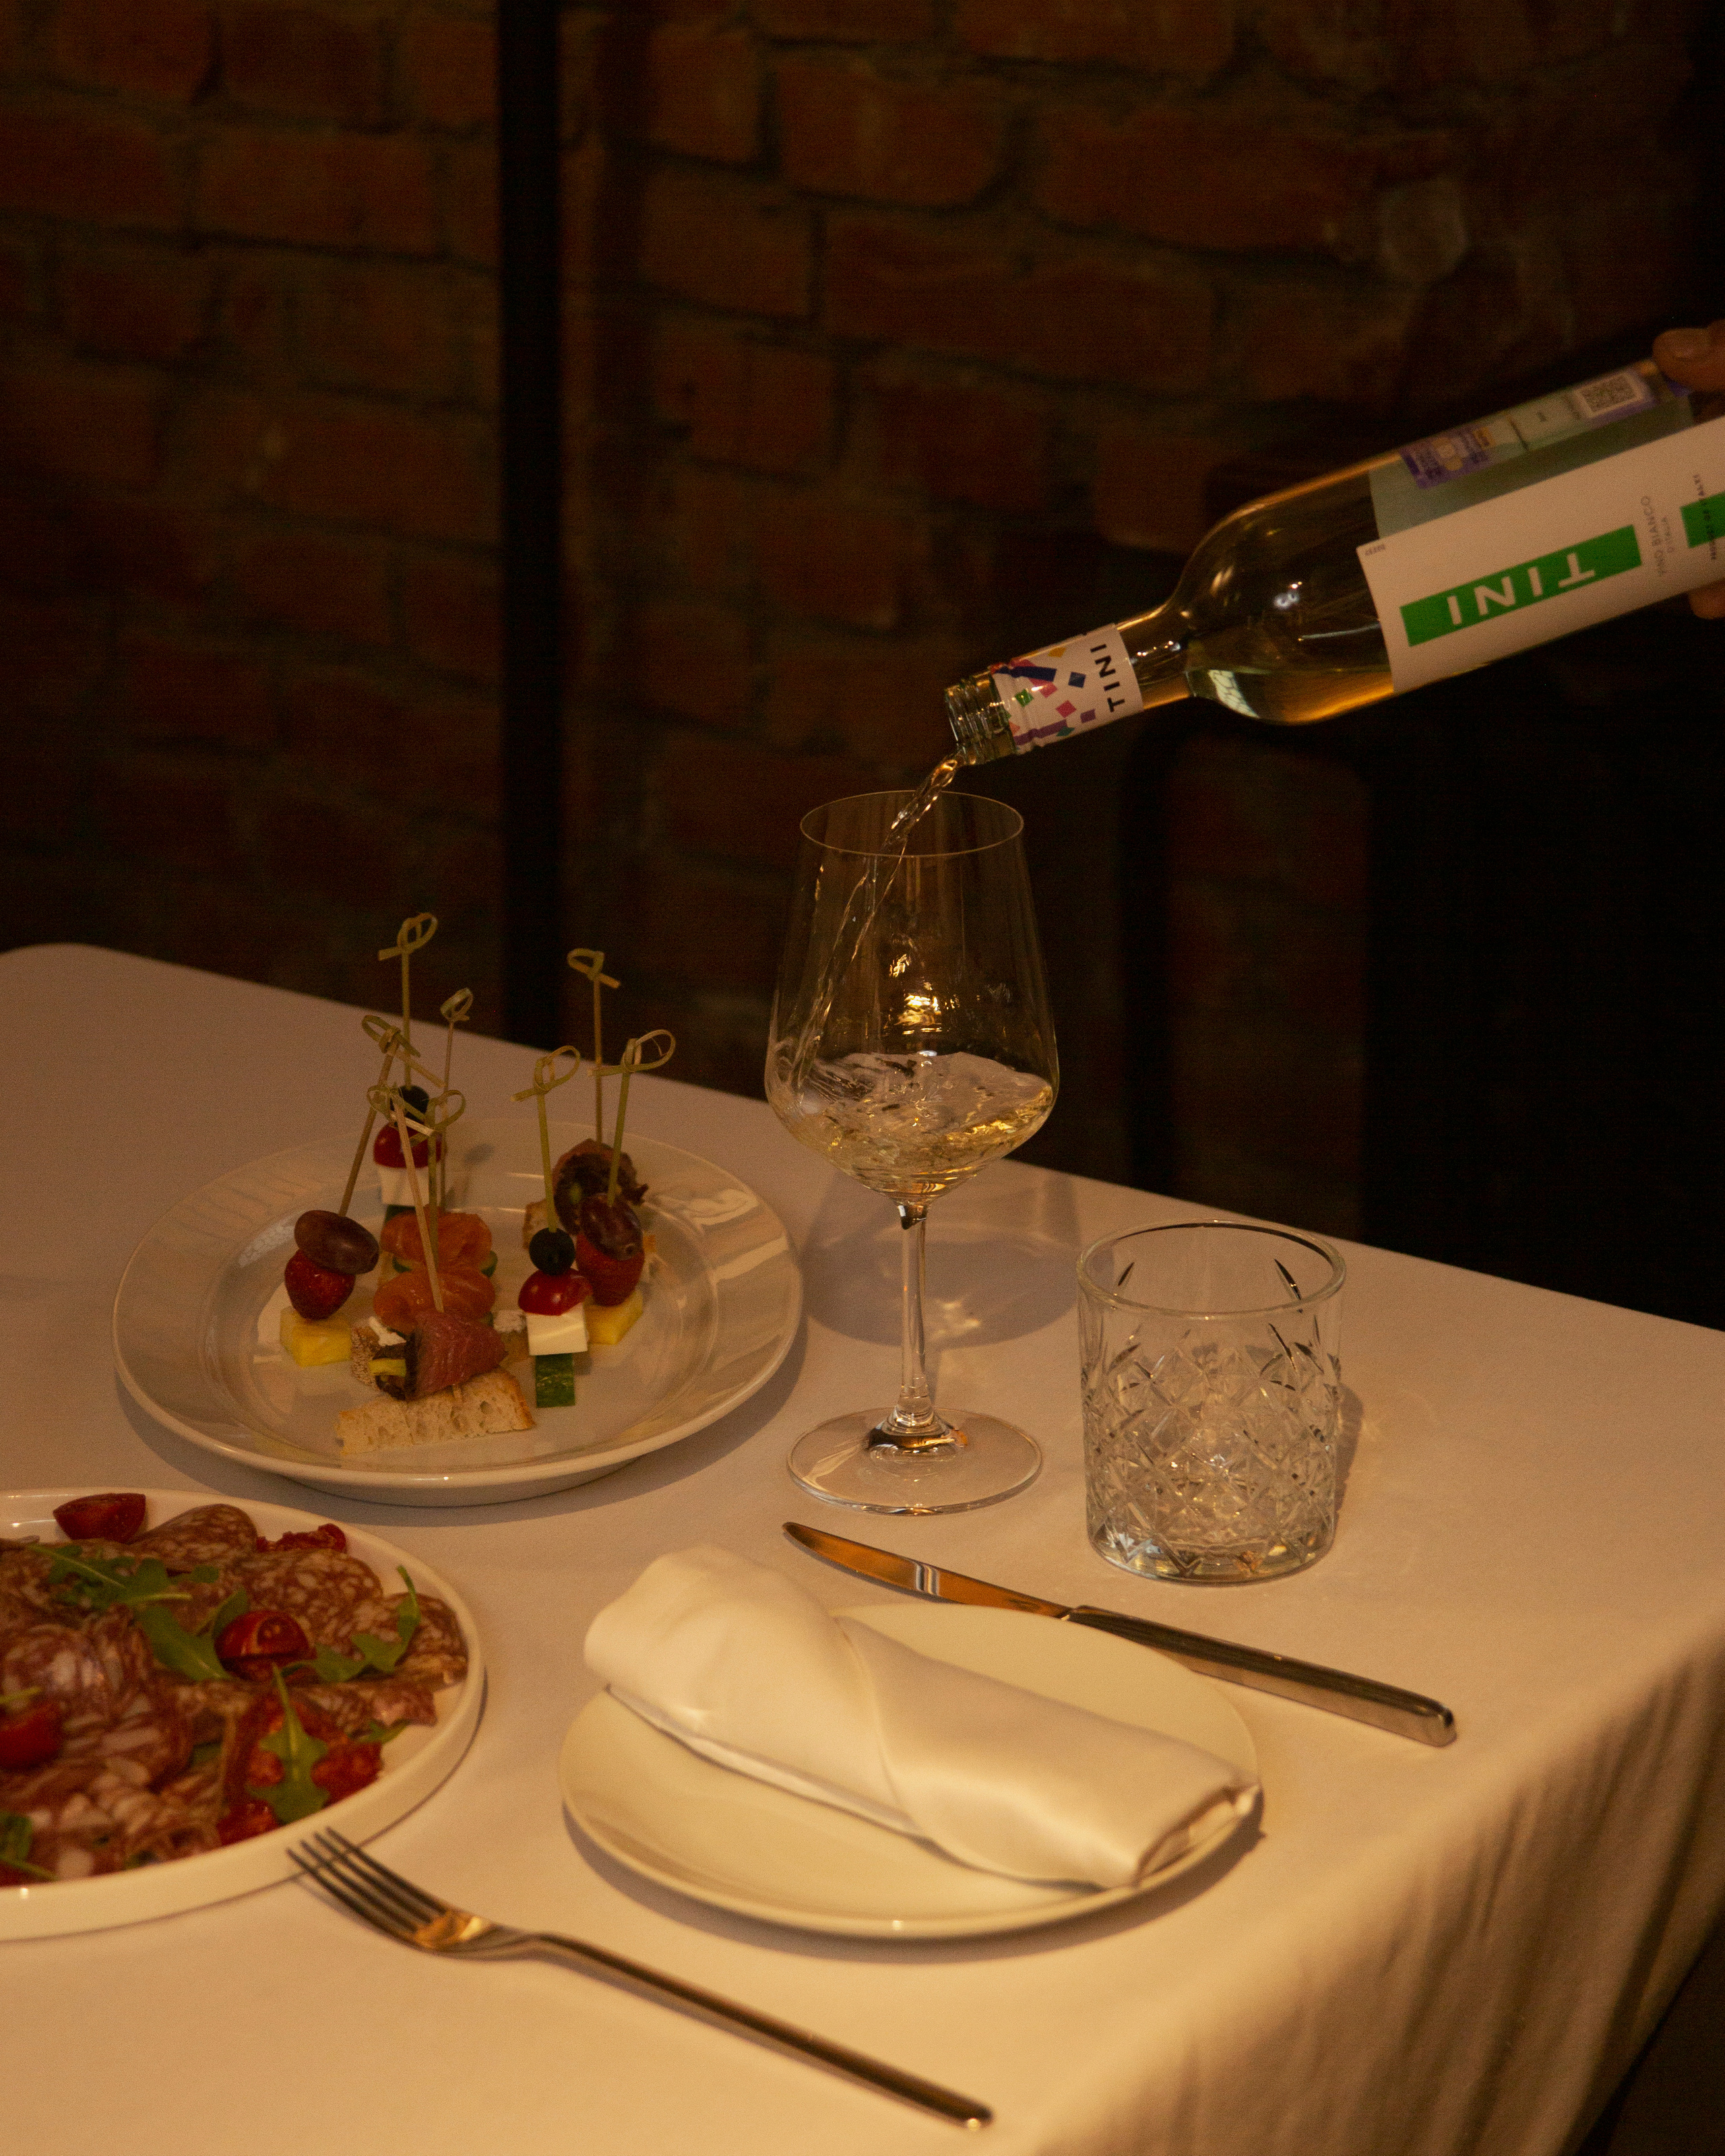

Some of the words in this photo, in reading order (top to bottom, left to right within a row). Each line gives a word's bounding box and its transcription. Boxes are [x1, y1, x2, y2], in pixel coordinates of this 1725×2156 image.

[1640, 495, 1662, 546] BIANCO
[1447, 552, 1596, 625] TINI
[1090, 643, 1126, 713] TINI
